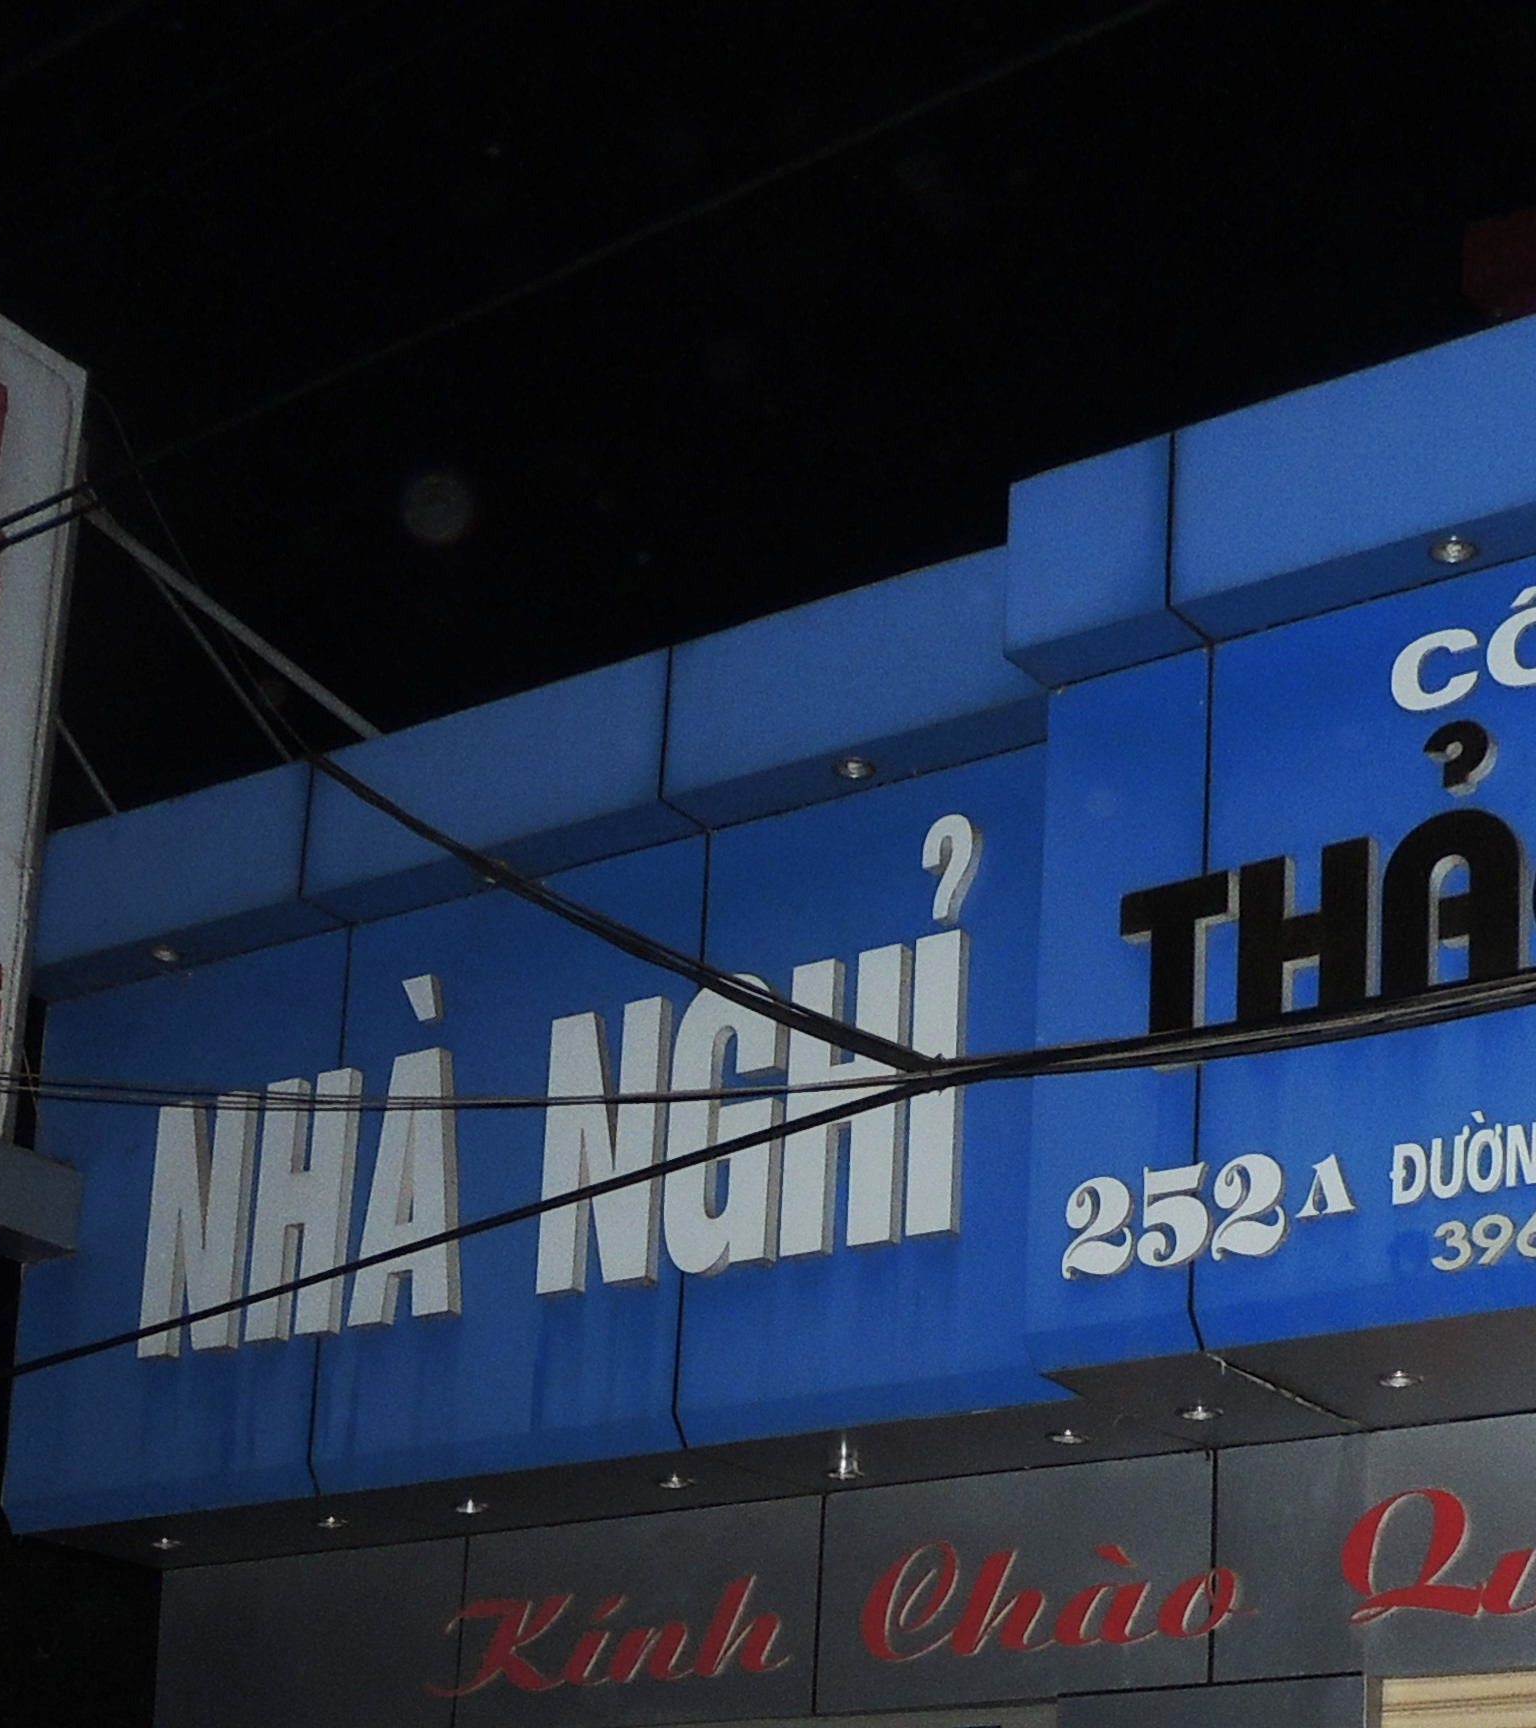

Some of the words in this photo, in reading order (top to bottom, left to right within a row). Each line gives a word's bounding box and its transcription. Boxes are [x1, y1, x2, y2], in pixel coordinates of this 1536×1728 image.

[138, 974, 462, 1358] NHÀ
[536, 813, 983, 1296] NGHỈ
[425, 1573, 792, 1698] Kính
[860, 1540, 1258, 1662] Chào
